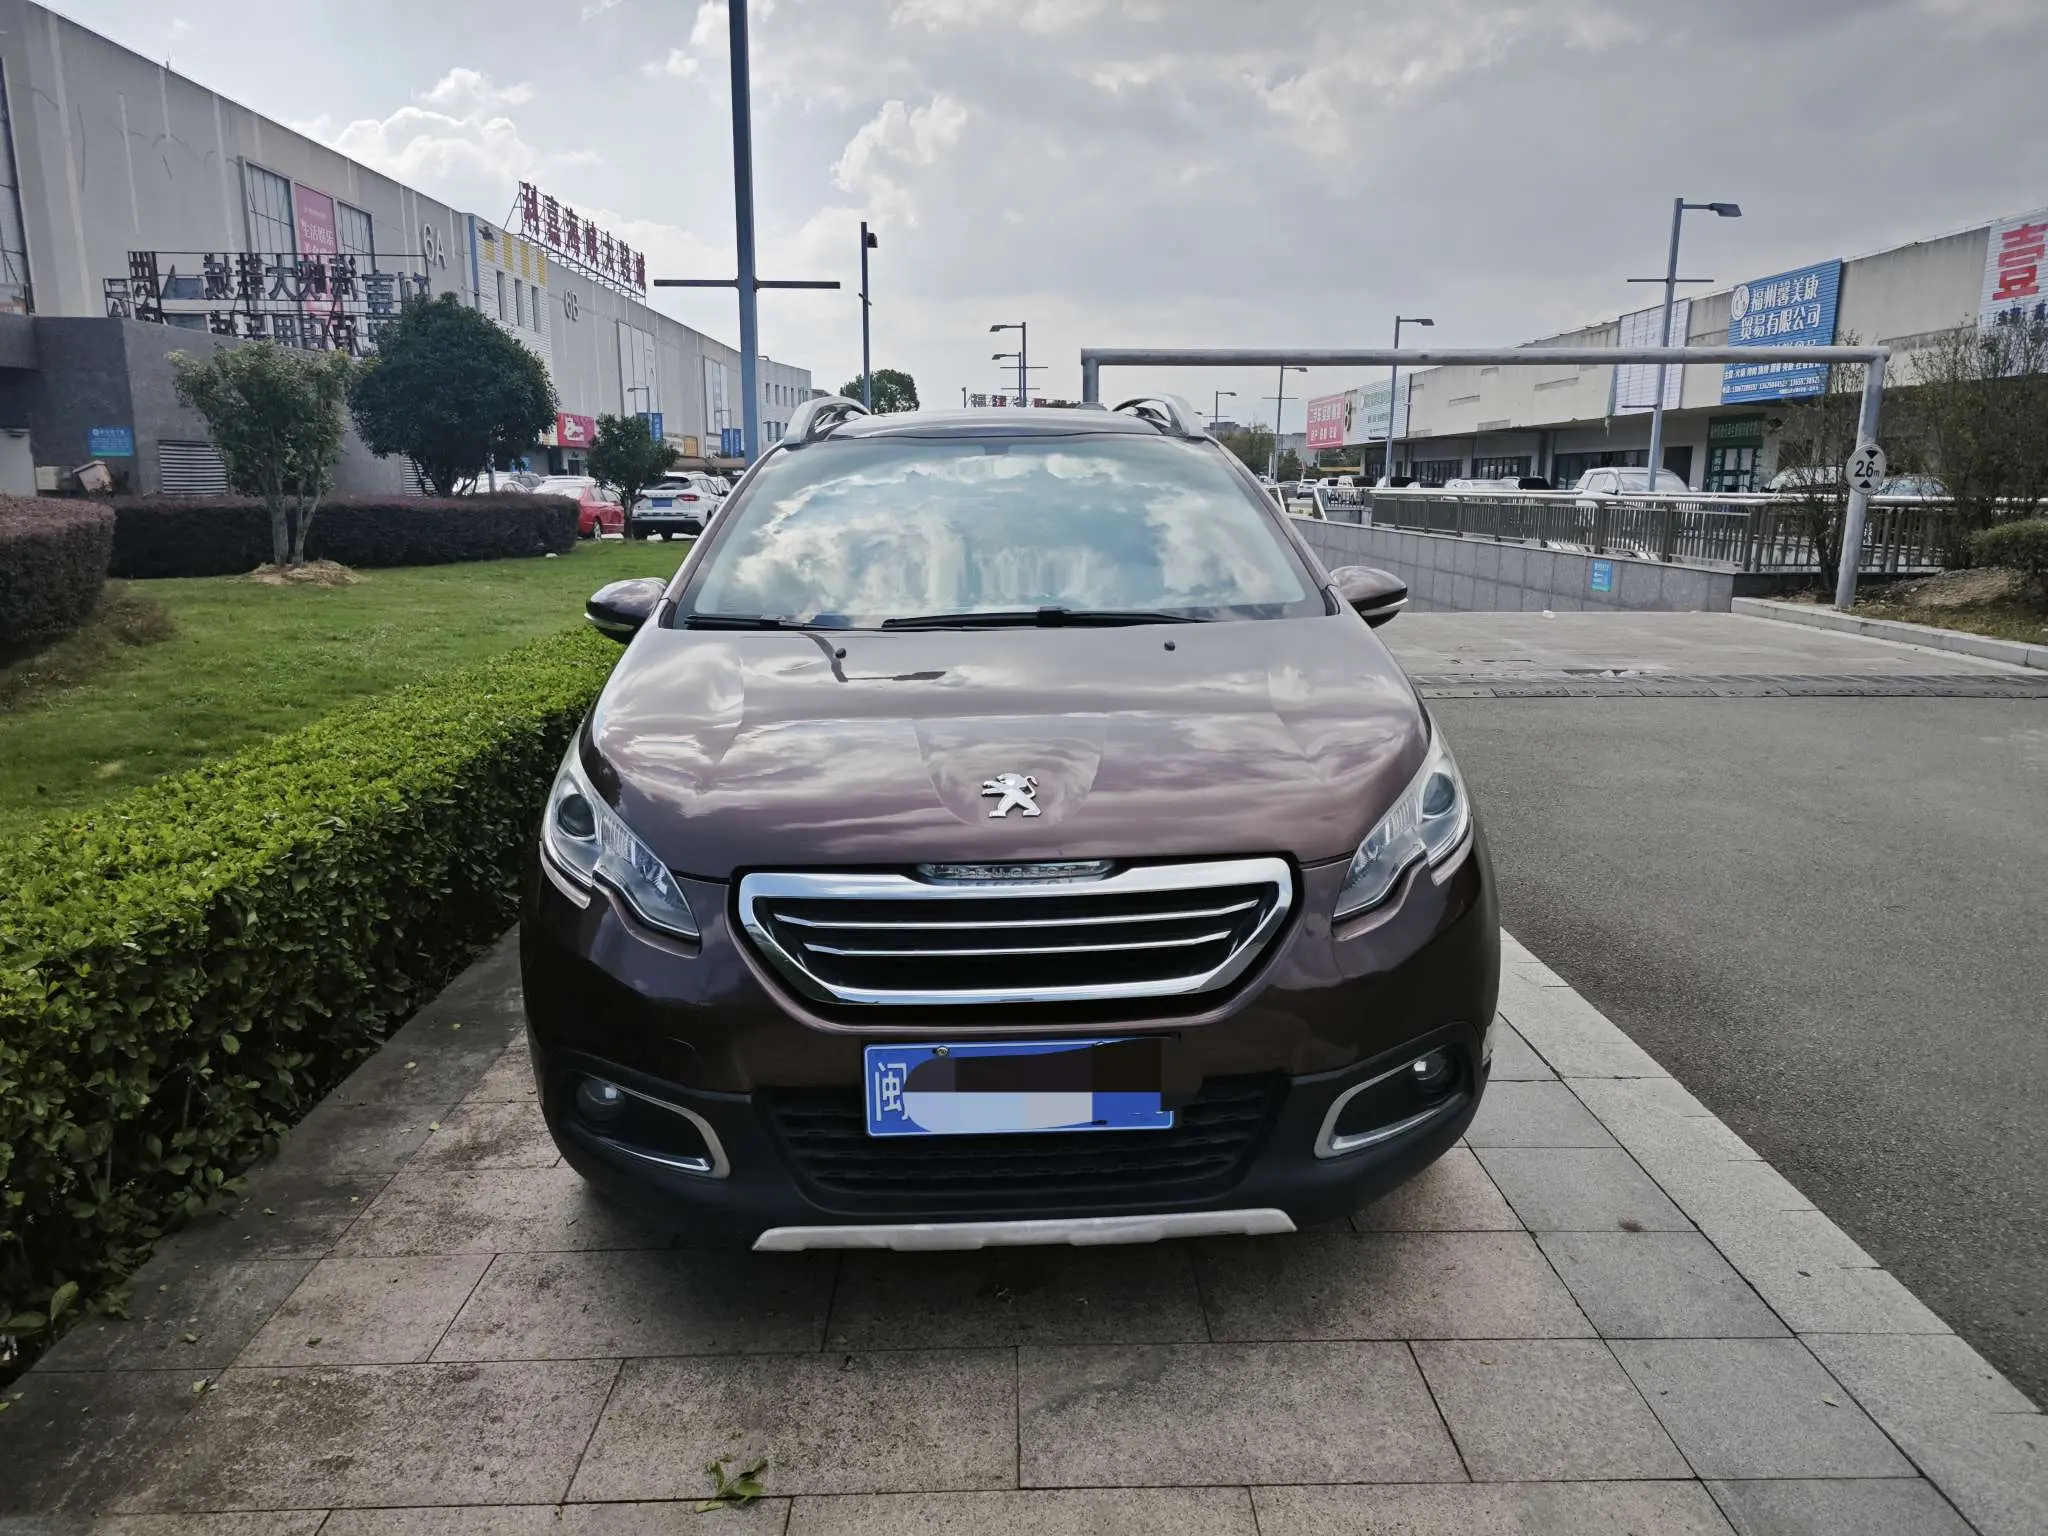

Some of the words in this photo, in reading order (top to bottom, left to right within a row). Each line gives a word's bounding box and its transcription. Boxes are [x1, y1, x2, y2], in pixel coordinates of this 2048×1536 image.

[423, 223, 447, 271] 6A
[1992, 224, 2048, 301] 壹
[564, 288, 580, 323] 6B
[1751, 275, 1819, 313] 福州馨美康
[1740, 303, 1821, 340] 贸易有限公司
[873, 1061, 909, 1122] 闽
